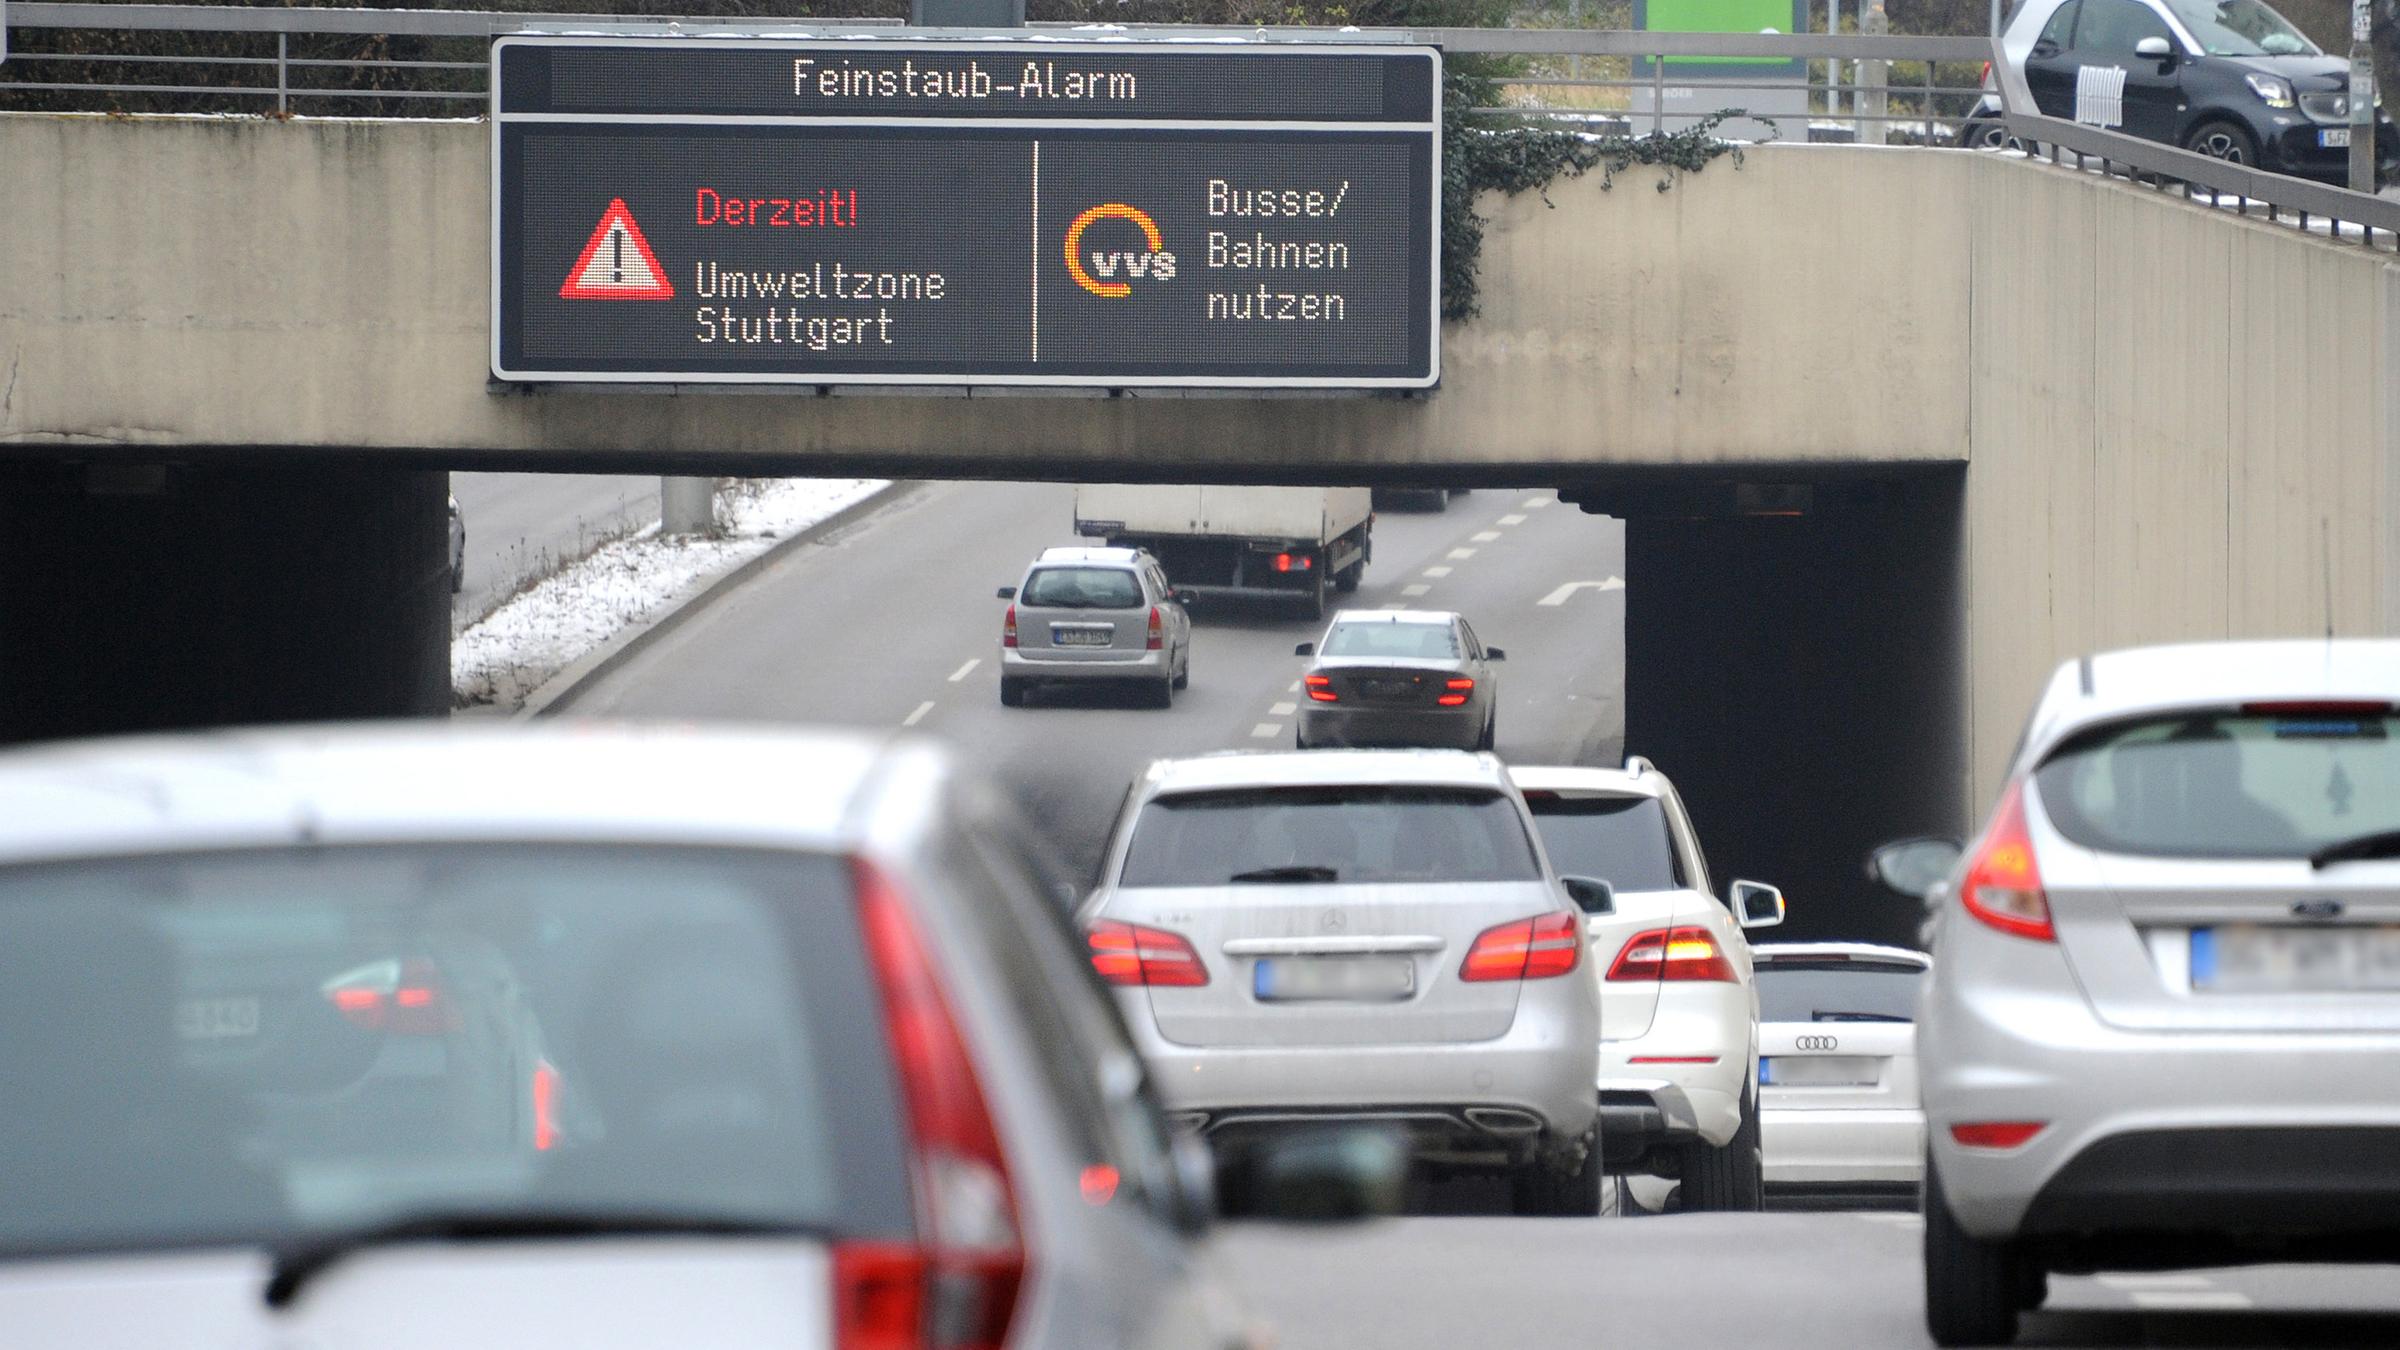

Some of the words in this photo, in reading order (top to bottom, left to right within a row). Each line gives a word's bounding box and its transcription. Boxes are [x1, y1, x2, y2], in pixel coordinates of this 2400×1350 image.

[793, 57, 1138, 100] Feinstaub-Alarm
[696, 187, 858, 227] Derzeit!
[1207, 179, 1349, 218] Busse/
[1207, 231, 1349, 269] Bahnen
[696, 261, 946, 300] Umweltzone
[1207, 283, 1346, 322] nutzen
[696, 306, 895, 352] Stuttgart
